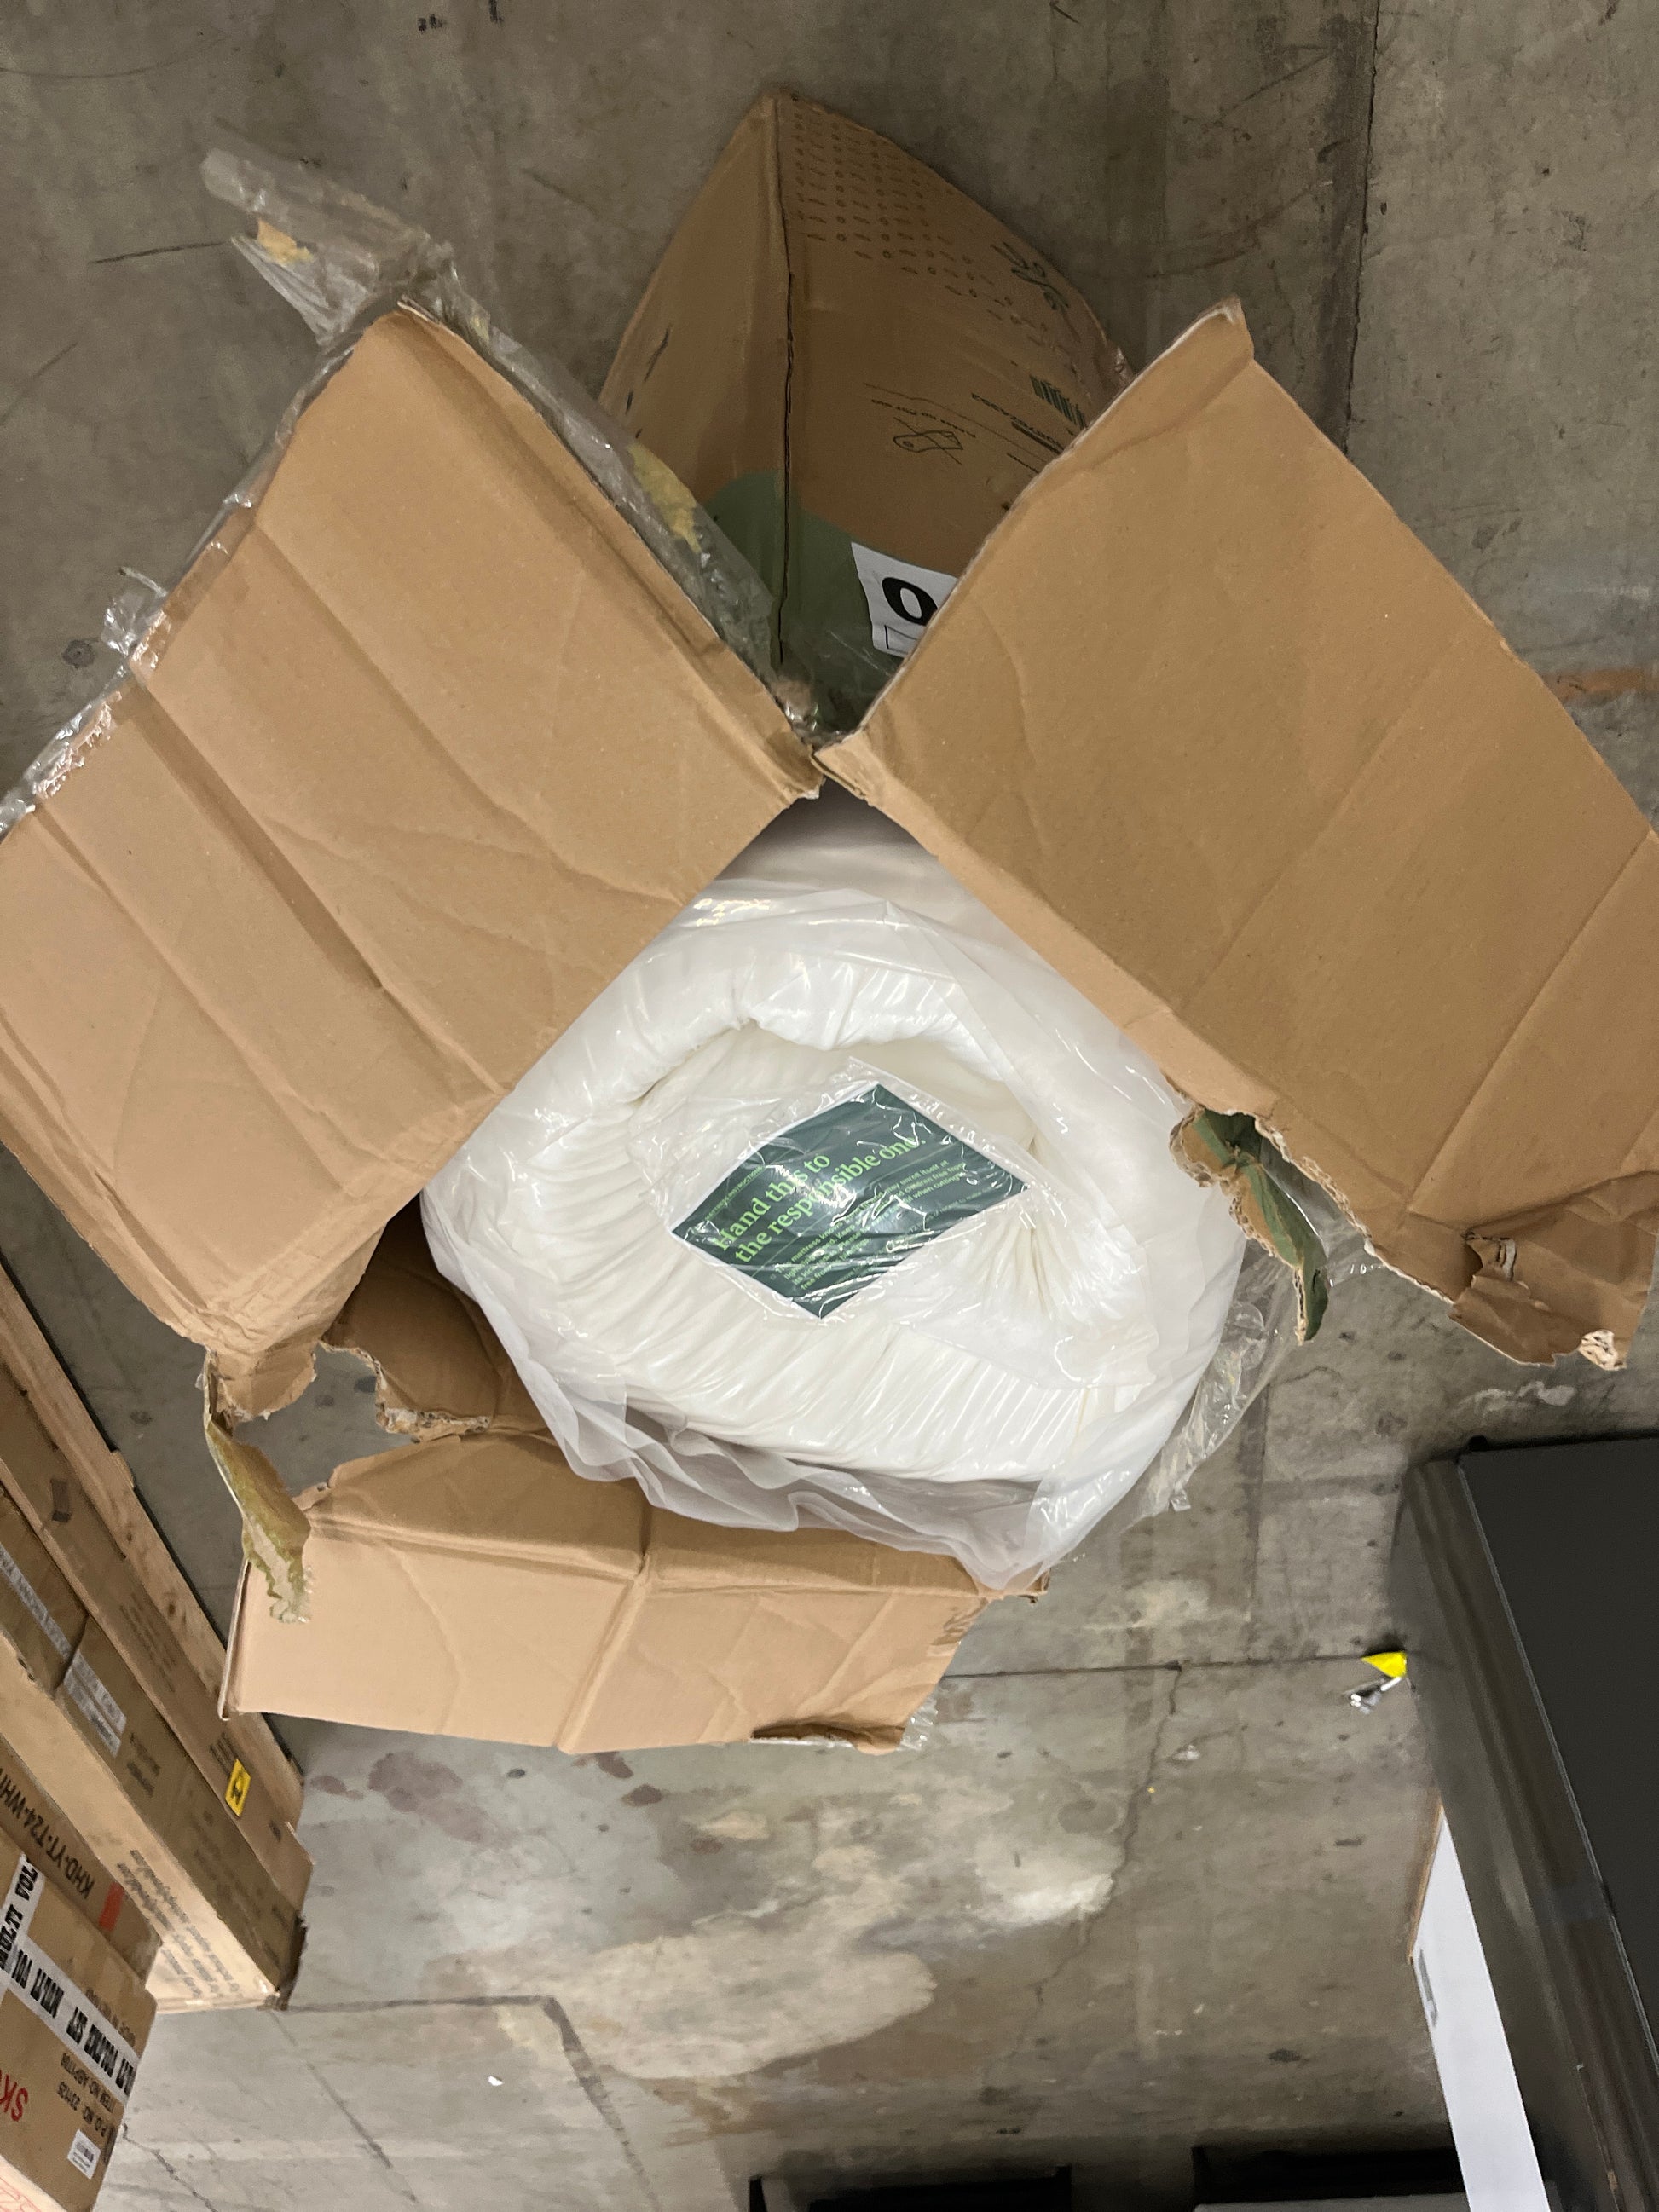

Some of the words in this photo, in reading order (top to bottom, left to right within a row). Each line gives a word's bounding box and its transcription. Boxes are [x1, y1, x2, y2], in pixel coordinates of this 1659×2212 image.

[713, 1198, 772, 1250] Hand
[765, 1169, 808, 1201] this
[804, 1152, 830, 1173] to
[737, 1231, 772, 1262] the
[766, 1157, 881, 1234] responsible
[879, 1135, 926, 1159] one.
[790, 1237, 821, 1262] mattress
[899, 1171, 922, 1185] unroll
[918, 1163, 939, 1174] itself
[912, 1187, 934, 1199] when
[835, 1223, 856, 1240] Keep
[801, 1278, 815, 1291] free
[14, 1857, 38, 1901] VOL
[11, 1949, 32, 1990] VOL
[0, 2069, 29, 2122] SK
